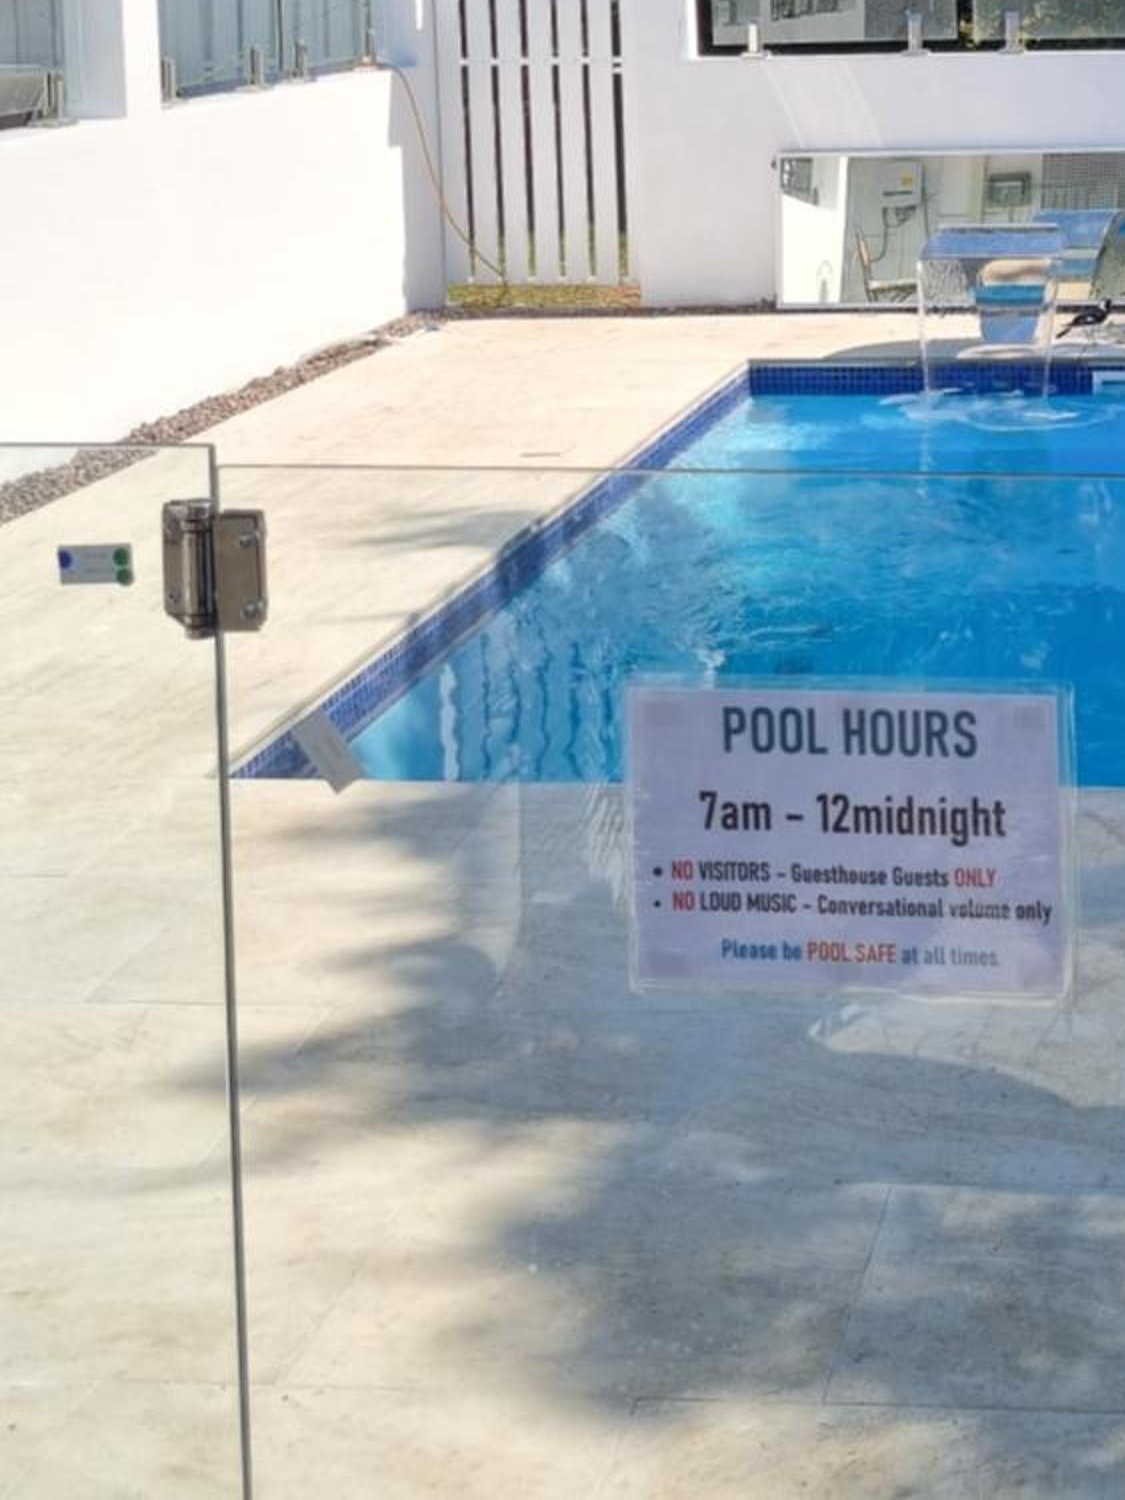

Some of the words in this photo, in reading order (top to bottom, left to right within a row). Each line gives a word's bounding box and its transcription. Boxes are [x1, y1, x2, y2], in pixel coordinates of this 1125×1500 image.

[722, 706, 828, 754] POOL
[842, 708, 977, 758] HOURS
[700, 790, 772, 831] 7am
[816, 794, 1006, 847] 12midnight
[672, 860, 693, 880] NO
[700, 861, 770, 882] VISITORS
[791, 863, 887, 886] Guesthouse
[892, 866, 949, 887] Guests
[954, 867, 996, 887] ONLY
[672, 891, 695, 911] NO
[701, 891, 741, 912] LOUD
[747, 893, 797, 914] MUSIC
[817, 894, 944, 917] Conversational
[950, 898, 1010, 919] volume
[1015, 901, 1052, 925] only
[721, 938, 777, 960] Please
[783, 940, 801, 961] be
[807, 941, 850, 962] POOL
[855, 943, 896, 963] SAFE
[901, 947, 917, 964] at
[923, 946, 945, 965] all
